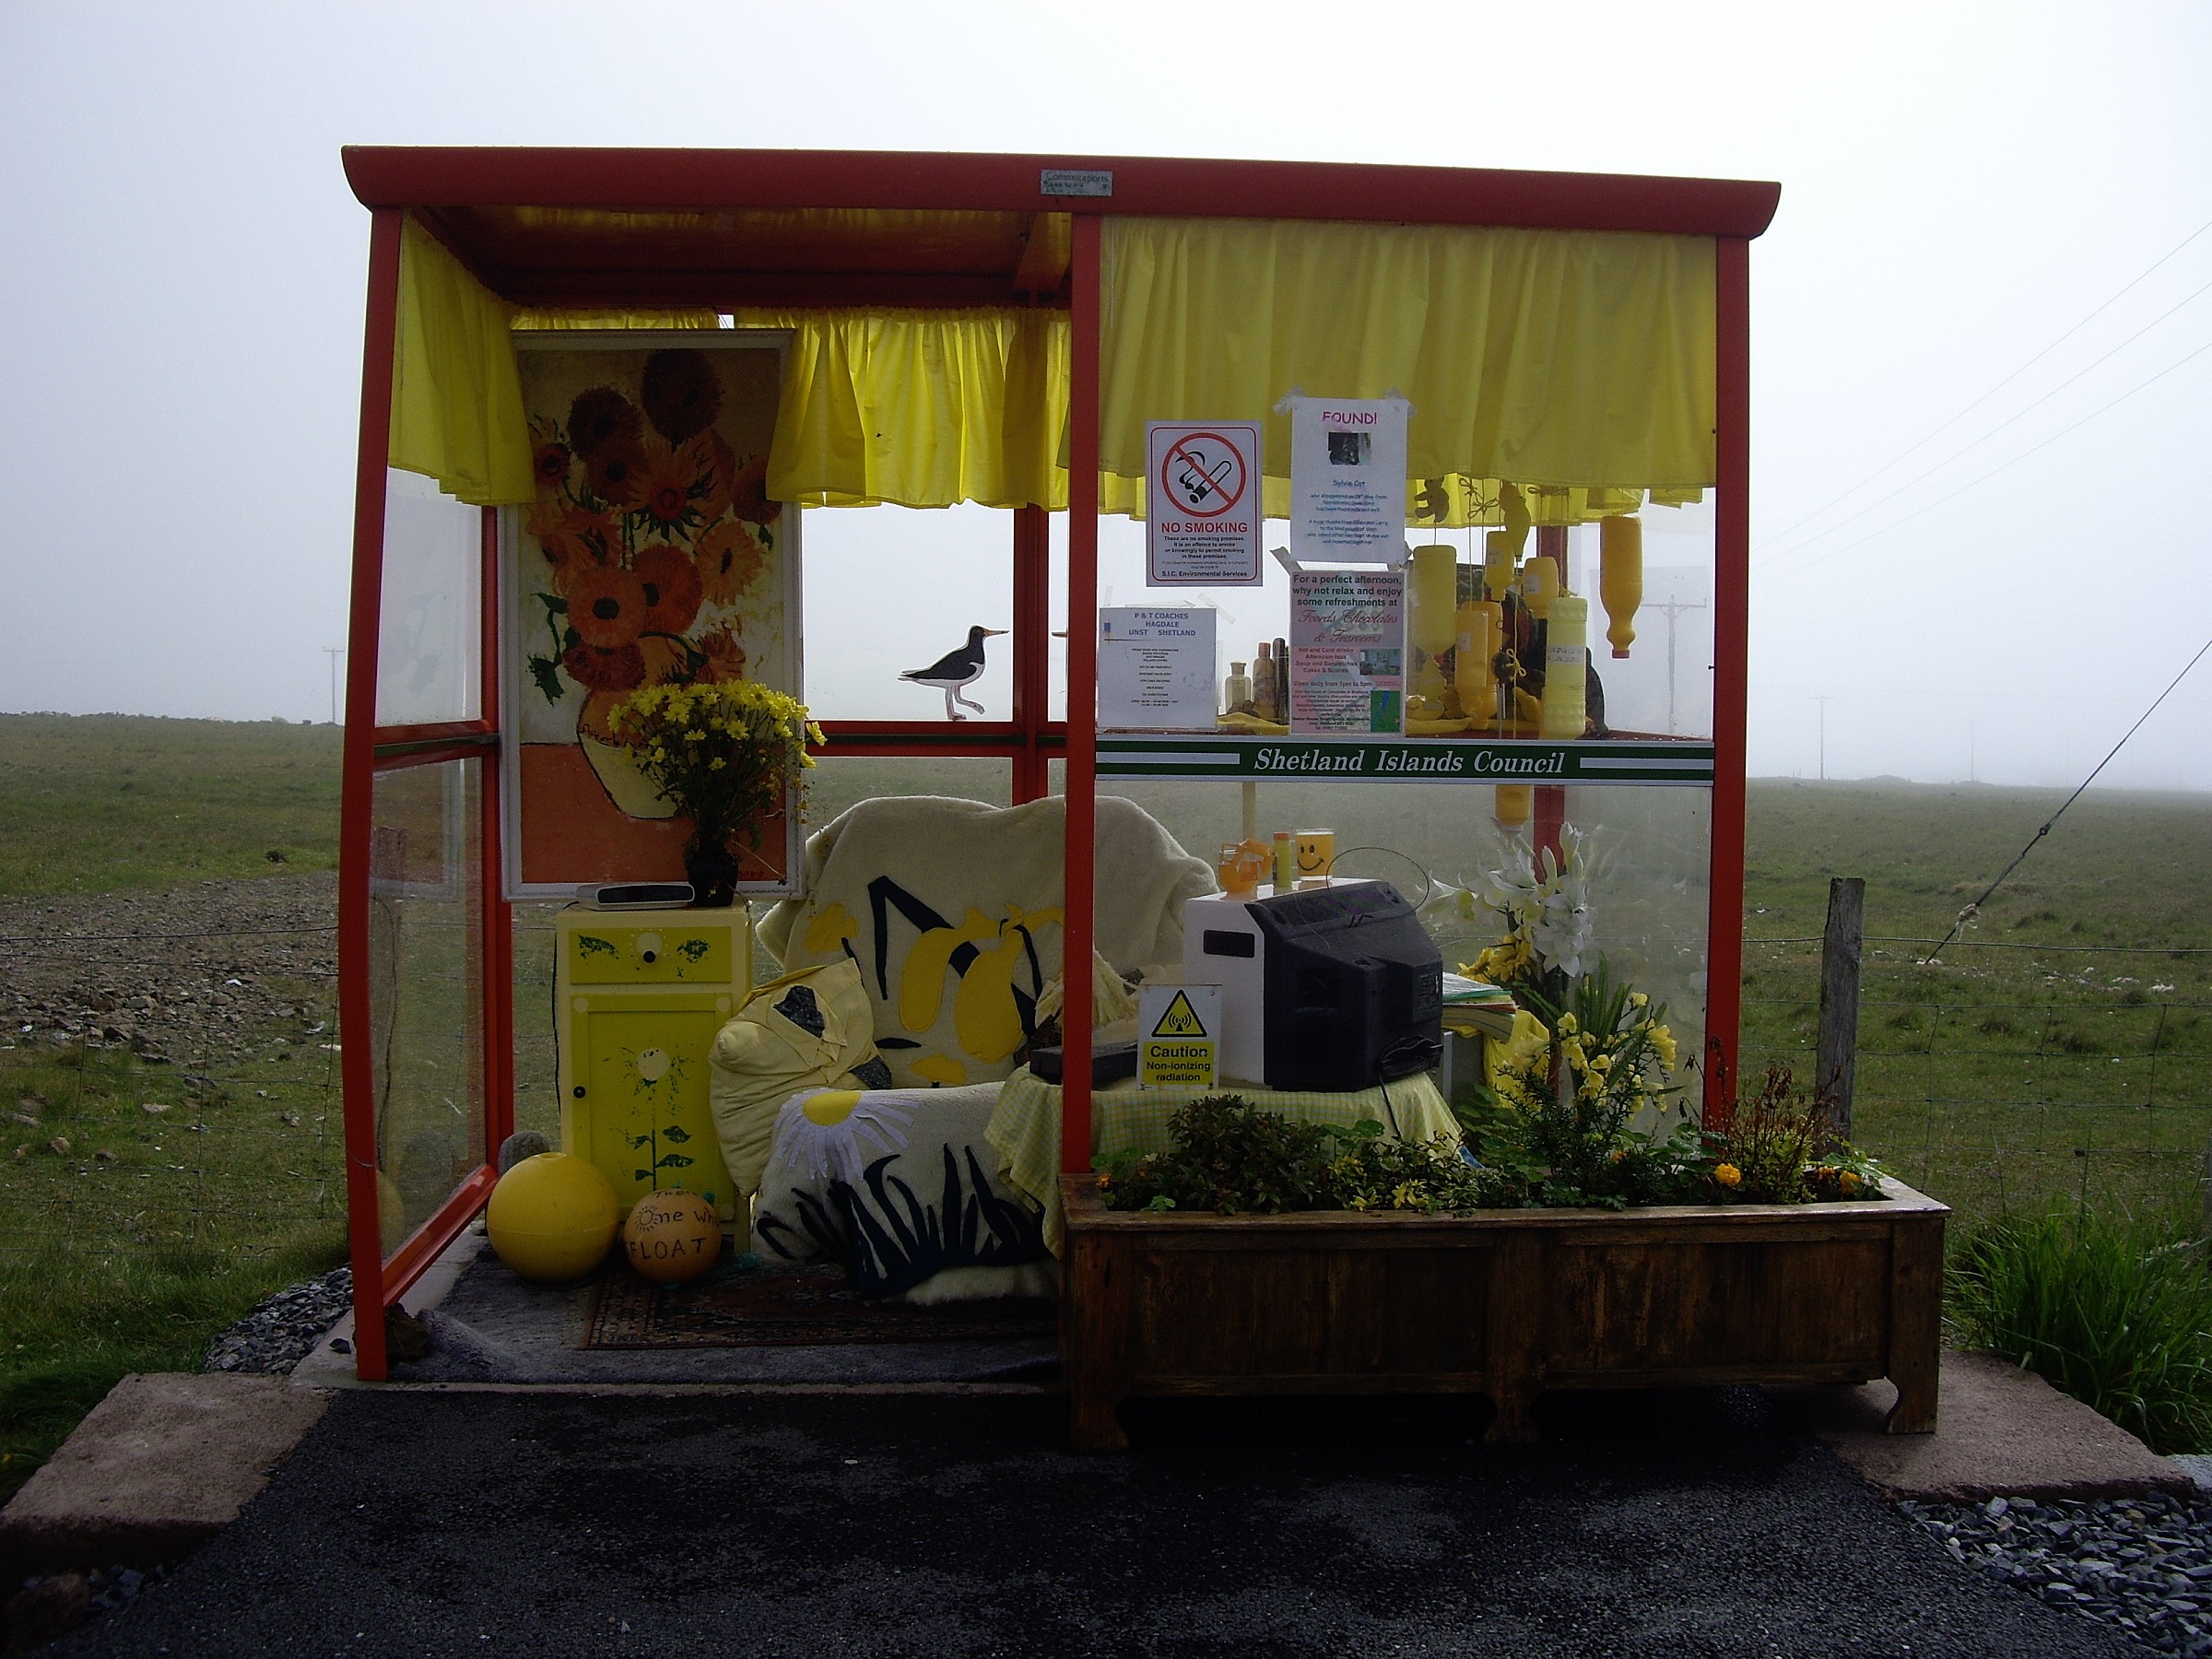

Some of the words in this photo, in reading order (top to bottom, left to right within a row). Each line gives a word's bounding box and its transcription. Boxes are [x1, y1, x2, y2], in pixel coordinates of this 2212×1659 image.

[1323, 411, 1377, 425] FOUND!
[1333, 479, 1353, 488] Sylvie
[1161, 523, 1181, 533] NO
[1185, 523, 1248, 533] SMOKING
[1294, 575, 1309, 583] For
[1320, 575, 1353, 584] perfect
[1355, 575, 1402, 584] afternoon,
[1292, 586, 1311, 595] why
[1357, 587, 1374, 595] and
[1377, 588, 1403, 597] enjoy
[1325, 598, 1386, 606] refreshments
[1342, 609, 1397, 623] Chocolates
[1313, 632, 1325, 642] &
[1330, 629, 1382, 643] Tearooms
[1253, 747, 1365, 771] Shetland
[1375, 749, 1465, 772] Islands
[1473, 750, 1566, 773] Council
[1150, 1045, 1208, 1058] Caution
[1147, 1062, 1211, 1072] Non-ionizing
[1156, 1073, 1200, 1081] radiation
[639, 1209, 684, 1226] One
[629, 1238, 707, 1260] FLOAT
